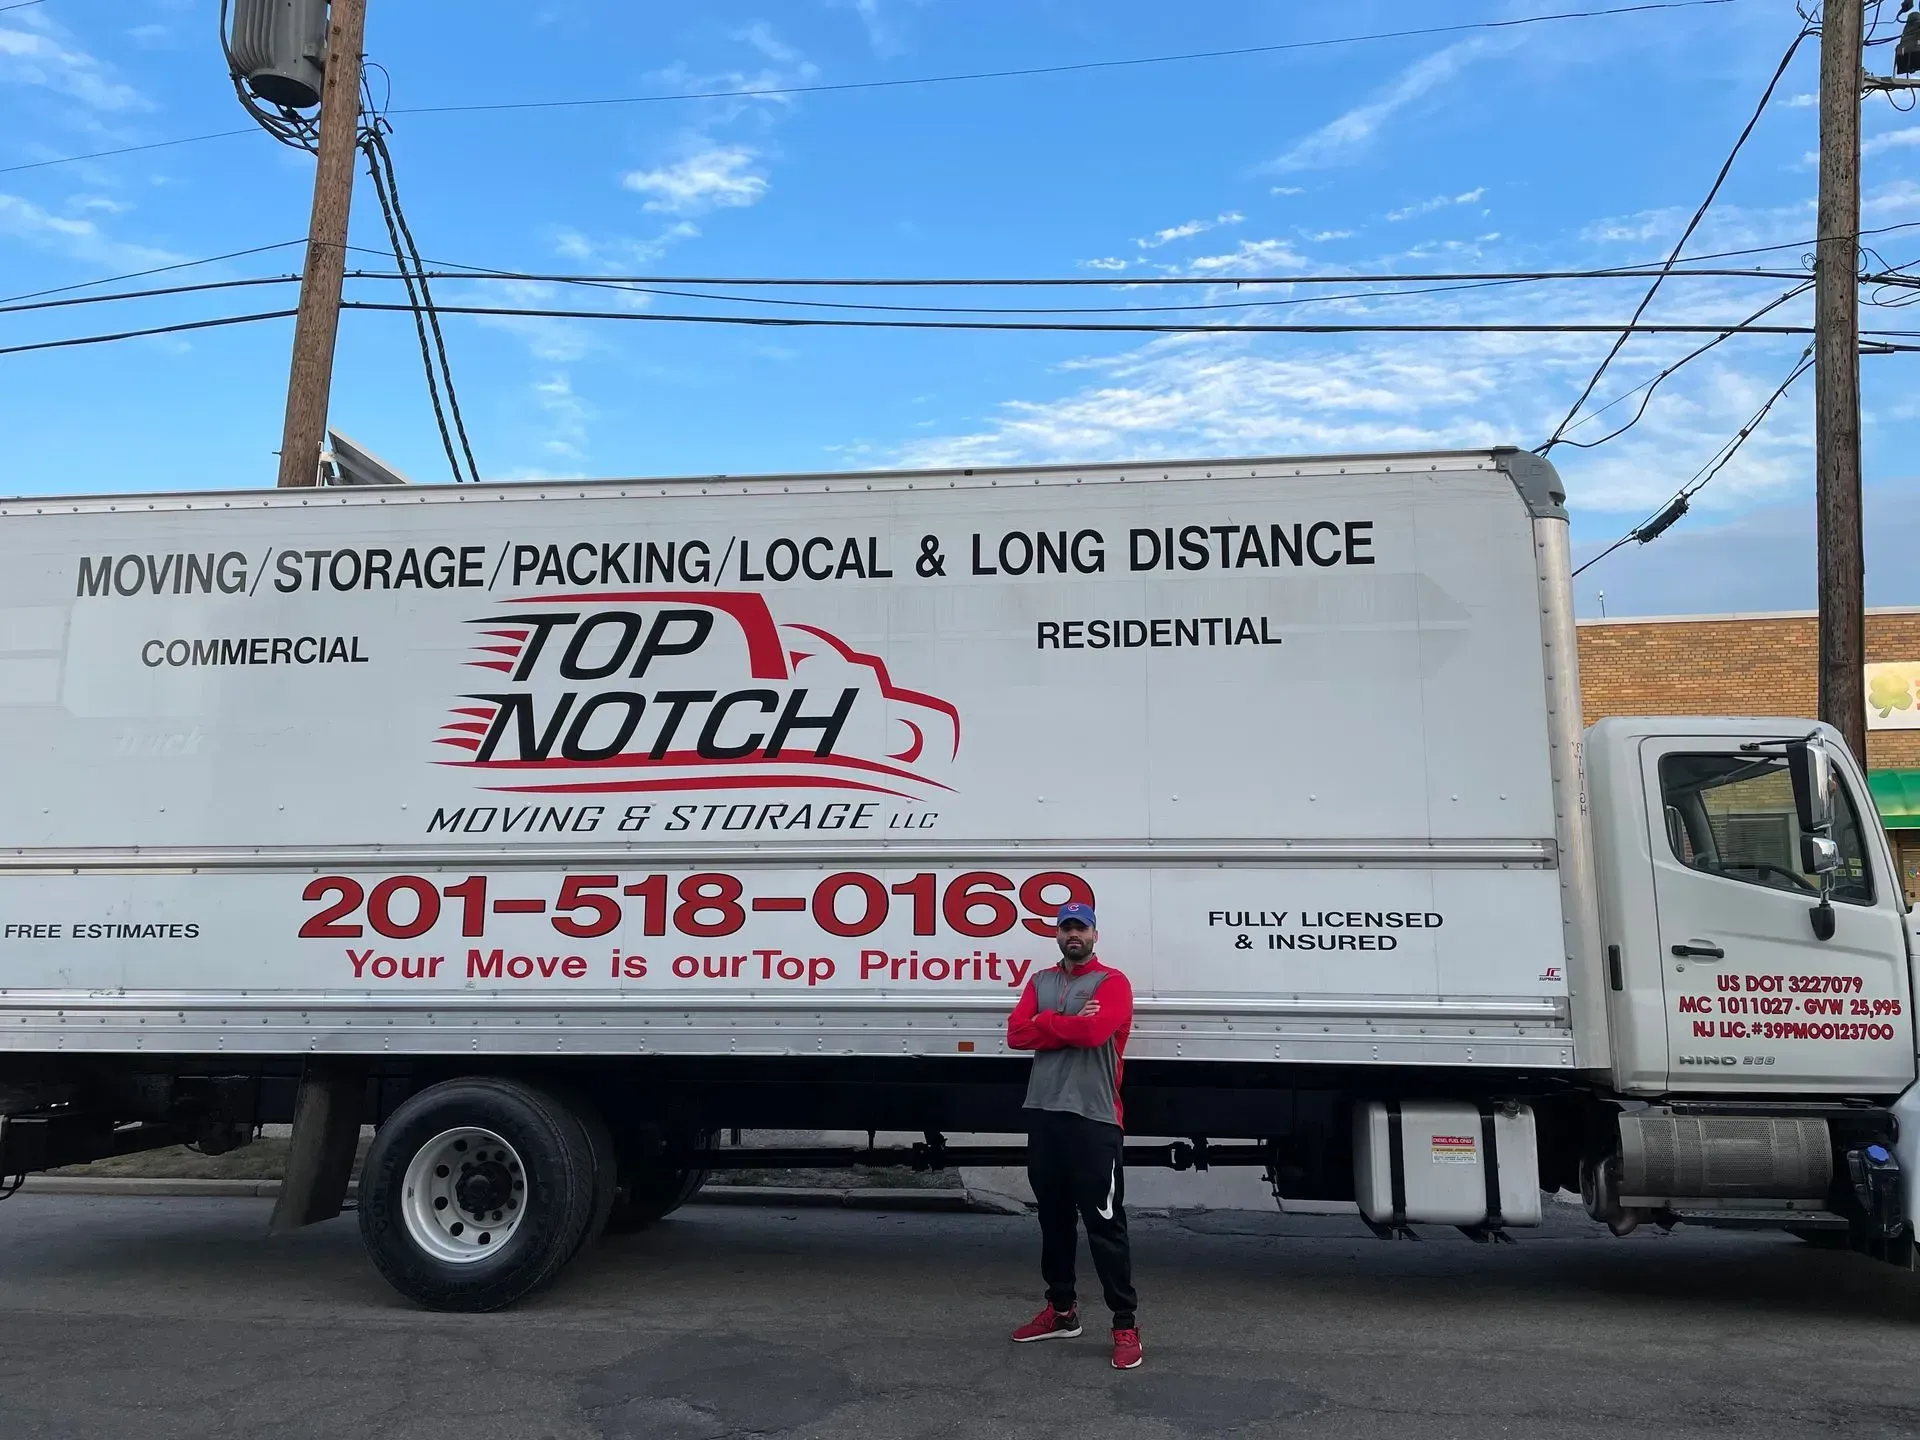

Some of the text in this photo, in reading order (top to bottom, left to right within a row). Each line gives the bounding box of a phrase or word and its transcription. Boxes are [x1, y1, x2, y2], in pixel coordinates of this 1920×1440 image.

[916, 534, 947, 578] &
[972, 529, 1105, 575] LONG
[1129, 519, 1376, 572] DISTANCE
[1037, 616, 1282, 649] RESIDENTIAL
[142, 636, 369, 667] COMMERCIAL
[461, 610, 713, 682] TOP
[455, 688, 860, 762] NOTCH
[426, 803, 939, 833] MOVING & STORAGE LLC
[297, 871, 1096, 938] 201-518-0169
[1068, 902, 1080, 911] C
[4, 923, 200, 939] FREE ESTIMATES
[1208, 911, 1444, 928] FULLY LICENSED
[1234, 933, 1398, 951] & INSURED
[346, 949, 444, 979] Your
[466, 949, 588, 979] Move
[612, 949, 648, 978] is
[860, 950, 1032, 987] Priority
[1717, 975, 1862, 993] US DOT 3227079
[1680, 996, 1711, 1013] MC
[1804, 998, 1843, 1015] GVW
[1850, 999, 1901, 1018] 25,995
[1693, 1021, 1714, 1037] NJ
[1679, 1055, 1776, 1066] HINO 268
